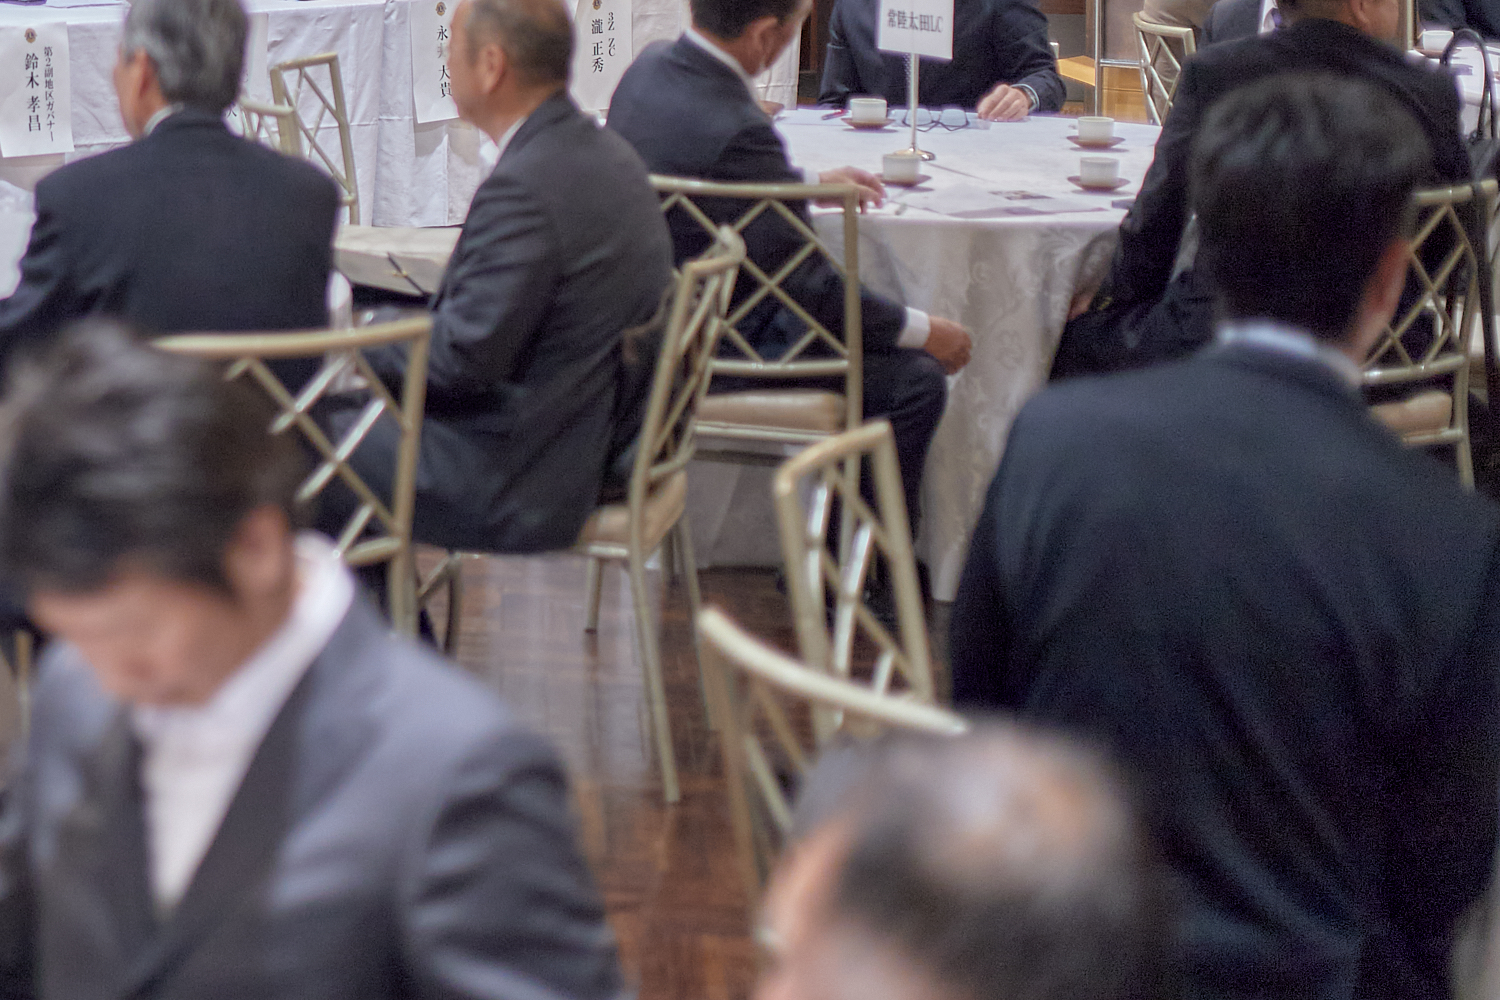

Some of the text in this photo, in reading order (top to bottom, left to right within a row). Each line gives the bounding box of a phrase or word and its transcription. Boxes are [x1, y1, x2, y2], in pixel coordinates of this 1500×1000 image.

[43, 46, 56, 143] 第2副地区ガバナー
